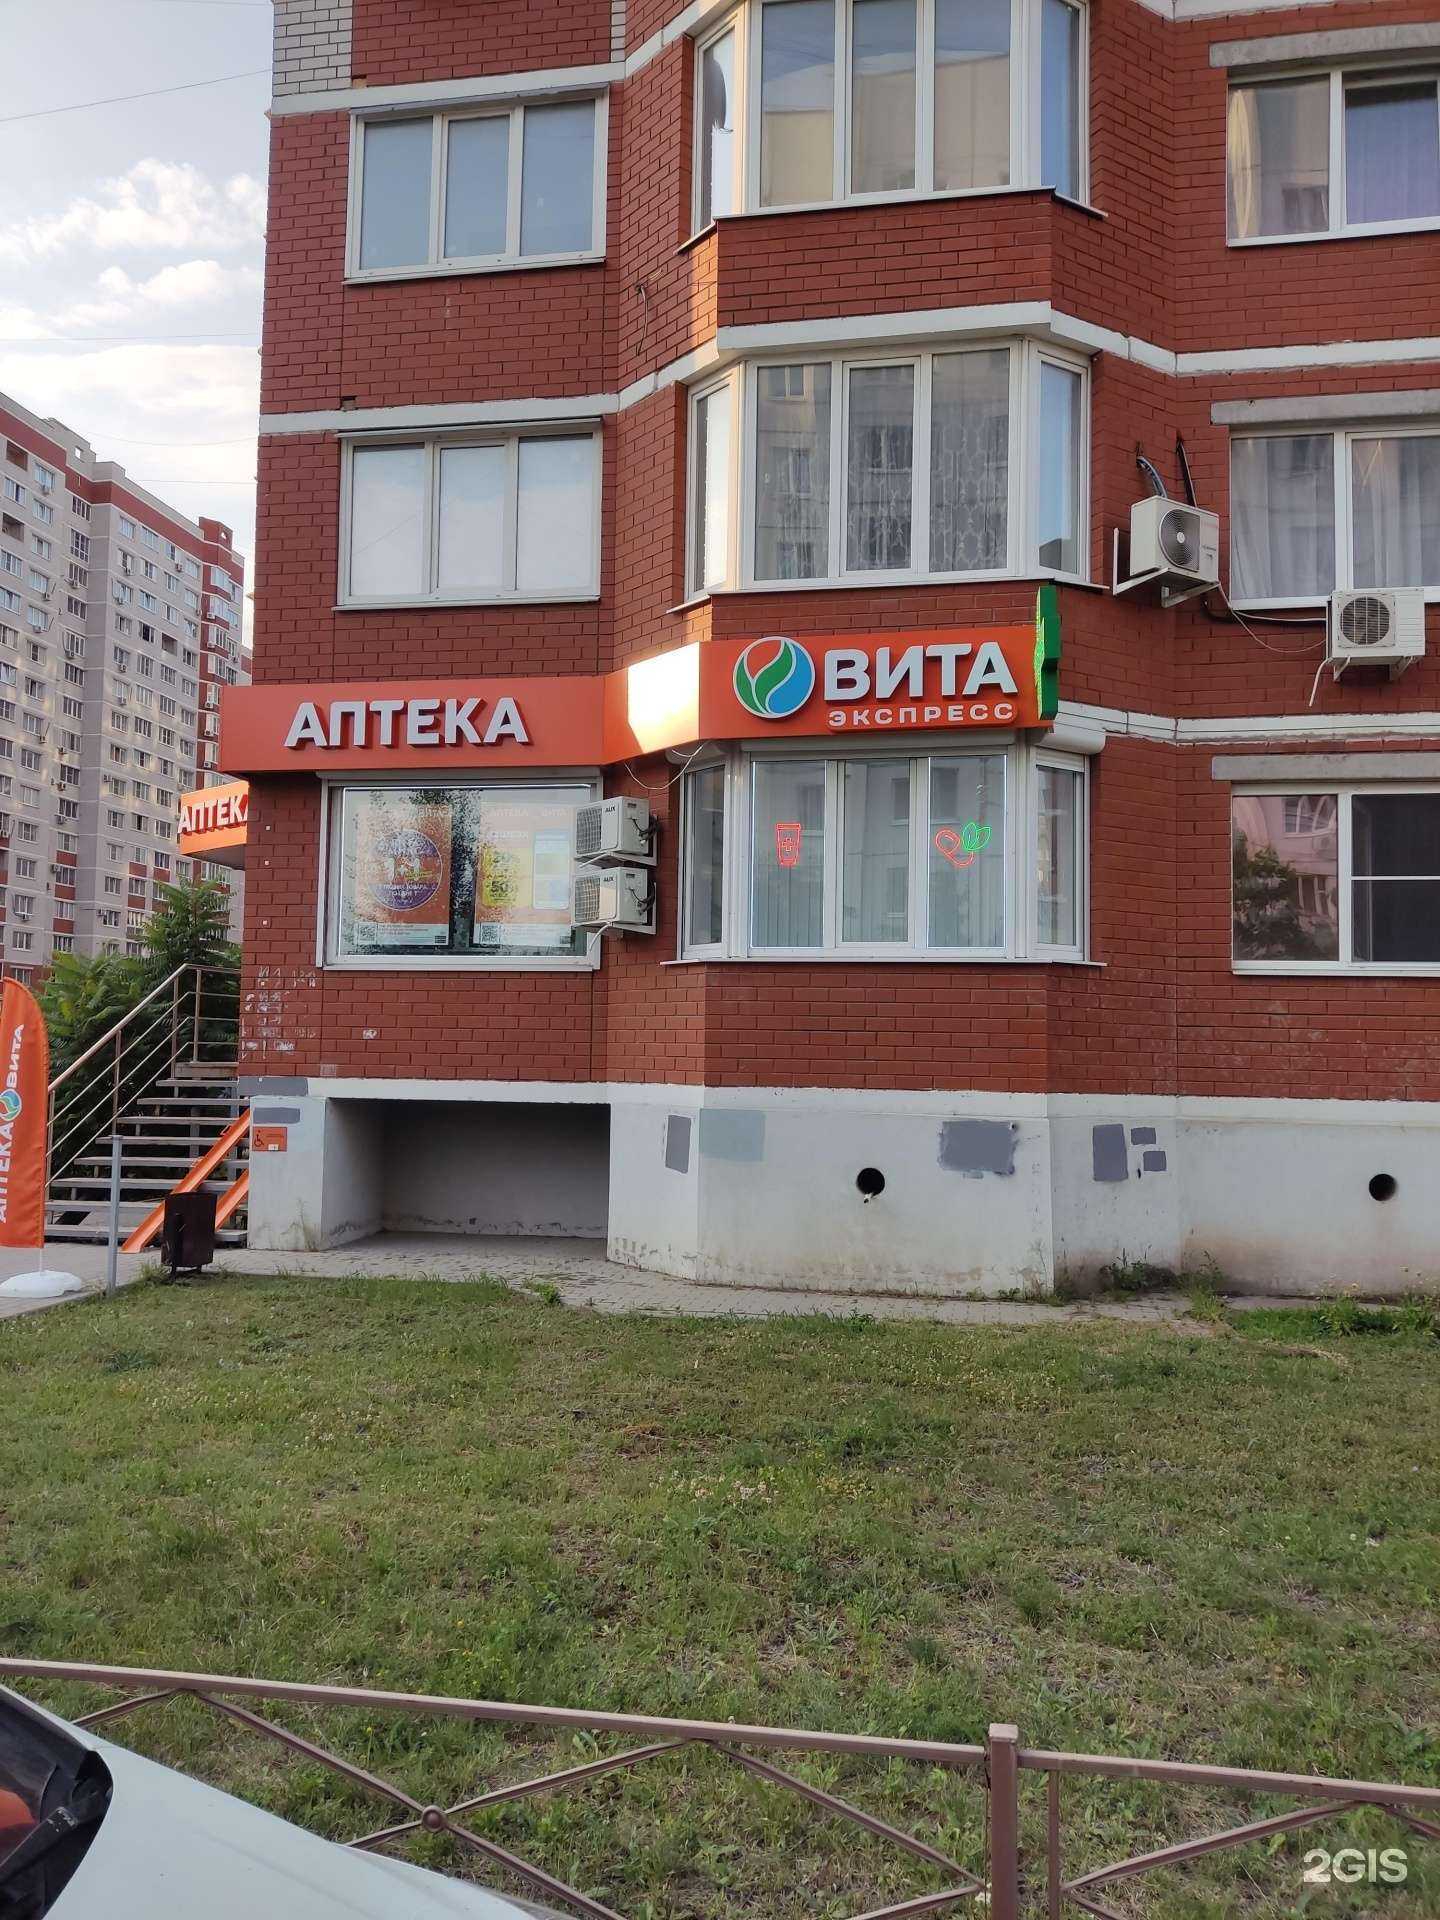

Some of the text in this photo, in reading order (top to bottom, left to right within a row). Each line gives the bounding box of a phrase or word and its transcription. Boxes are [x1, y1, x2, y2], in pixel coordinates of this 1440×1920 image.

[824, 642, 1018, 700] ВИТА
[284, 697, 530, 747] АПТЕКА
[828, 703, 1013, 727] ЭКСПРЕСС
[178, 794, 248, 834] АПТЕК
[6, 1024, 25, 1088] ВИТА
